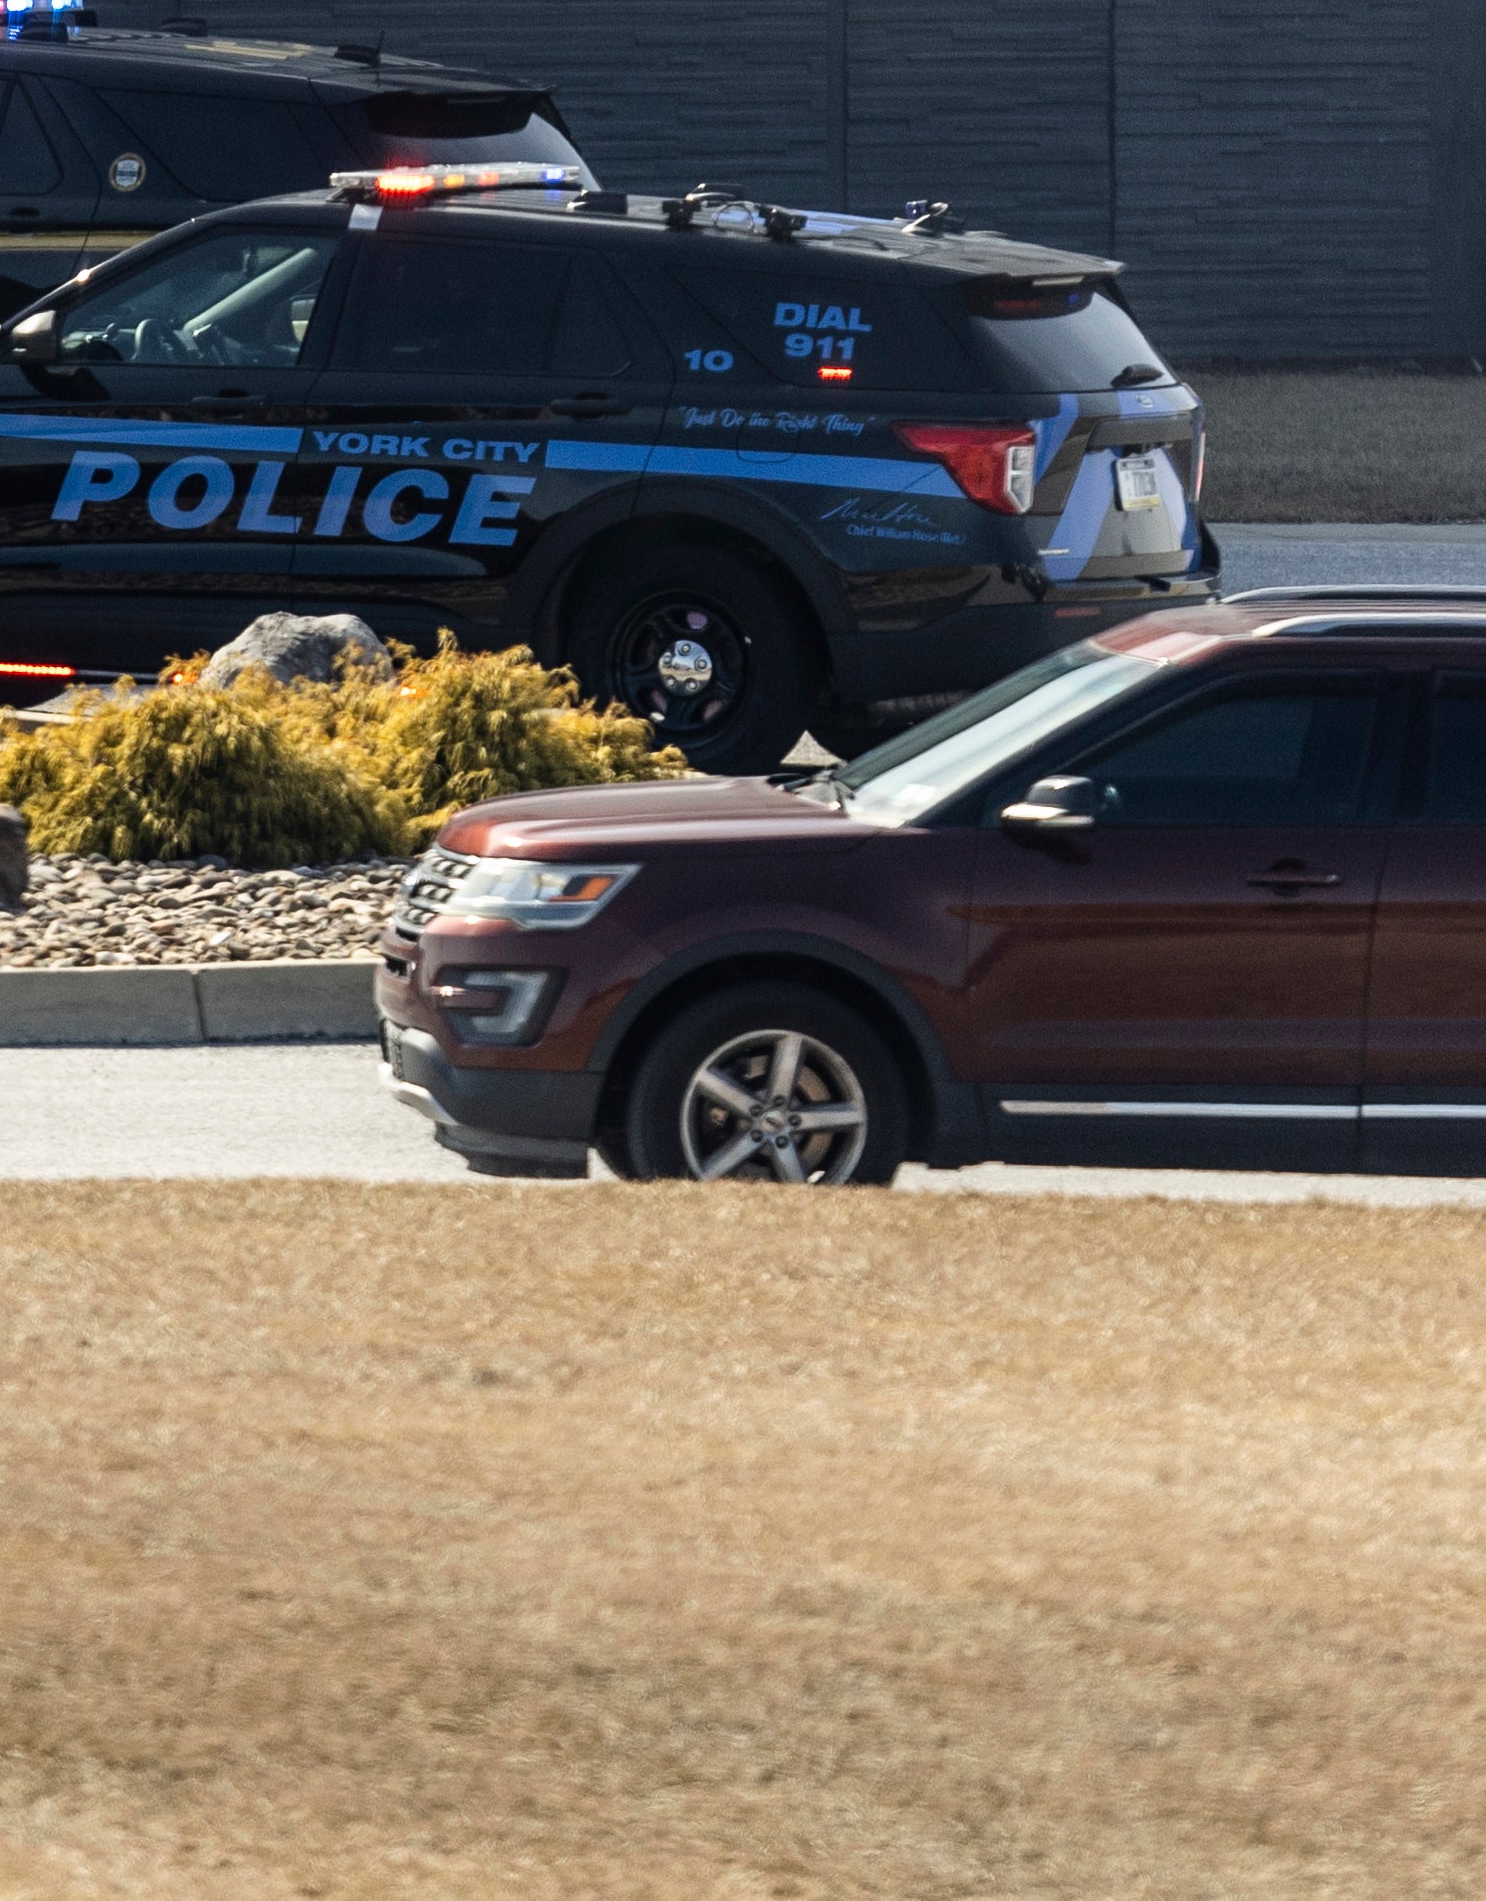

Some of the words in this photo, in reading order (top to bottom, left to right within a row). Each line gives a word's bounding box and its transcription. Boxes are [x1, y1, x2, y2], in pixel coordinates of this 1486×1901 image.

[774, 302, 872, 333] DIAL
[684, 348, 734, 373] 10
[784, 333, 856, 361] 911
[720, 407, 745, 428] Do
[312, 430, 430, 459] YORK
[442, 437, 541, 462] CITY
[50, 449, 536, 548] POLICE
